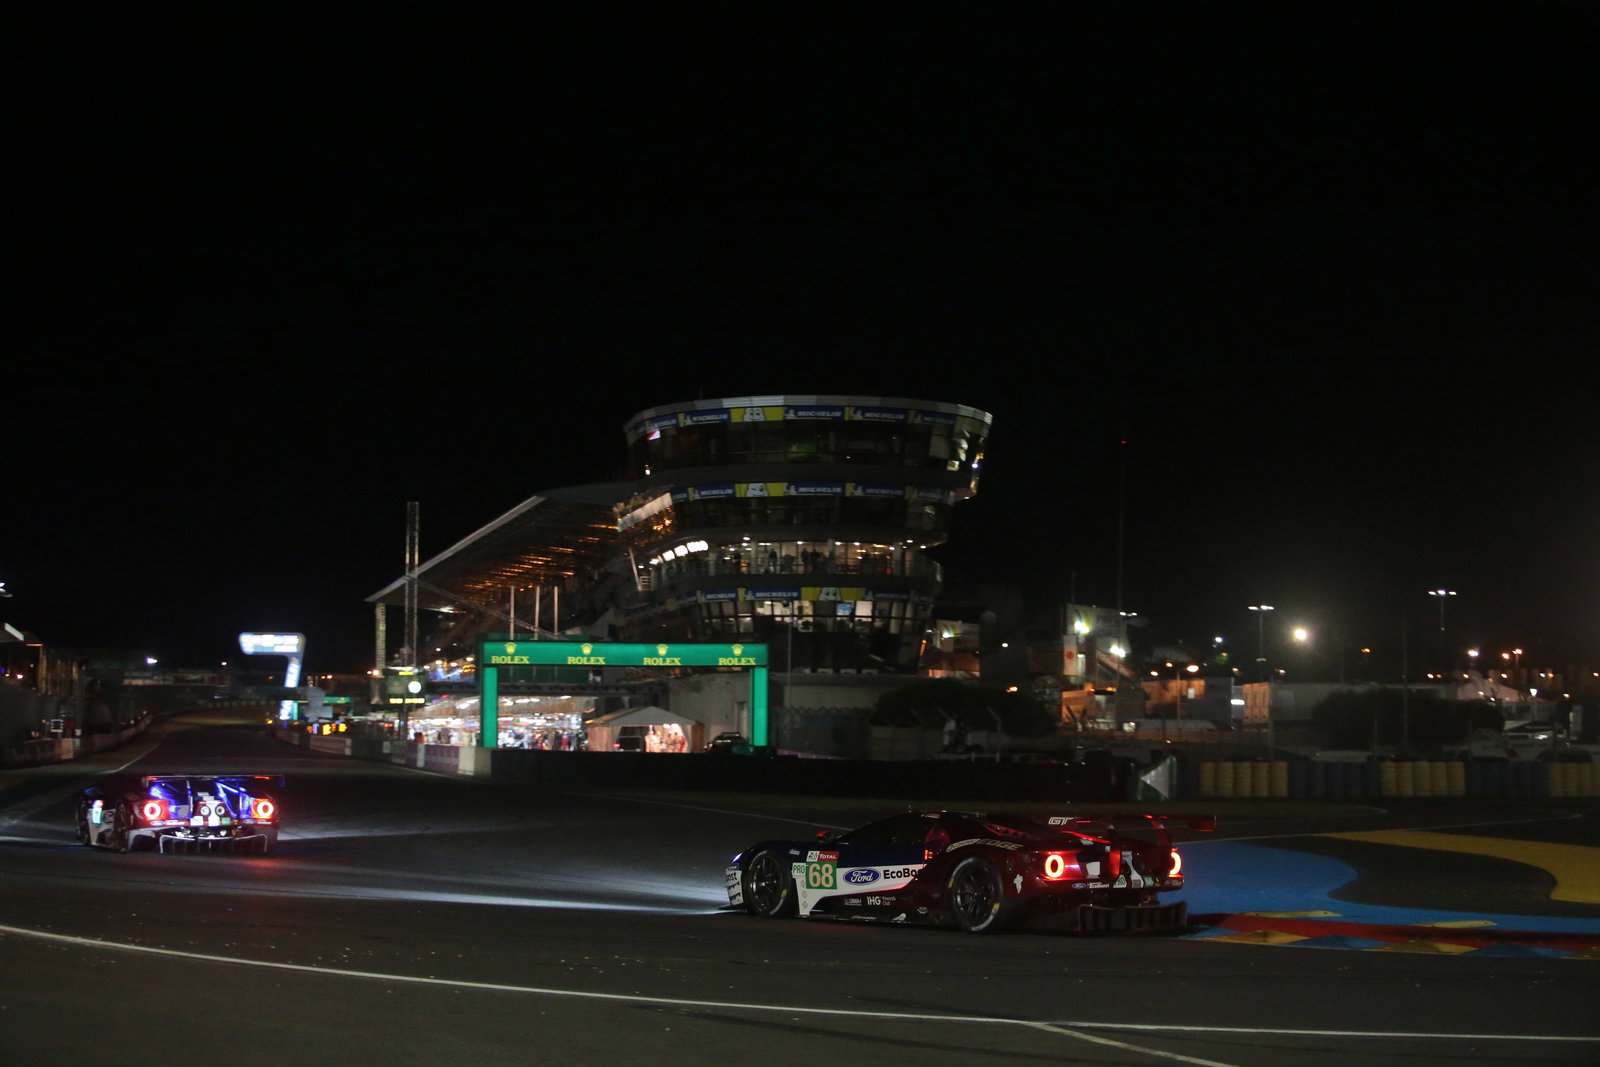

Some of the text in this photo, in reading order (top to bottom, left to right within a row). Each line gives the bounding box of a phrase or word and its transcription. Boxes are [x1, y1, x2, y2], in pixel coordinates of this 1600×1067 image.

[491, 656, 530, 664] ROLEX
[567, 656, 606, 665] ROLEX
[643, 657, 682, 666] ROLEX
[718, 657, 756, 666] ROLEX
[793, 864, 805, 874] PRO
[809, 863, 834, 888] 68
[850, 870, 874, 883] Ford
